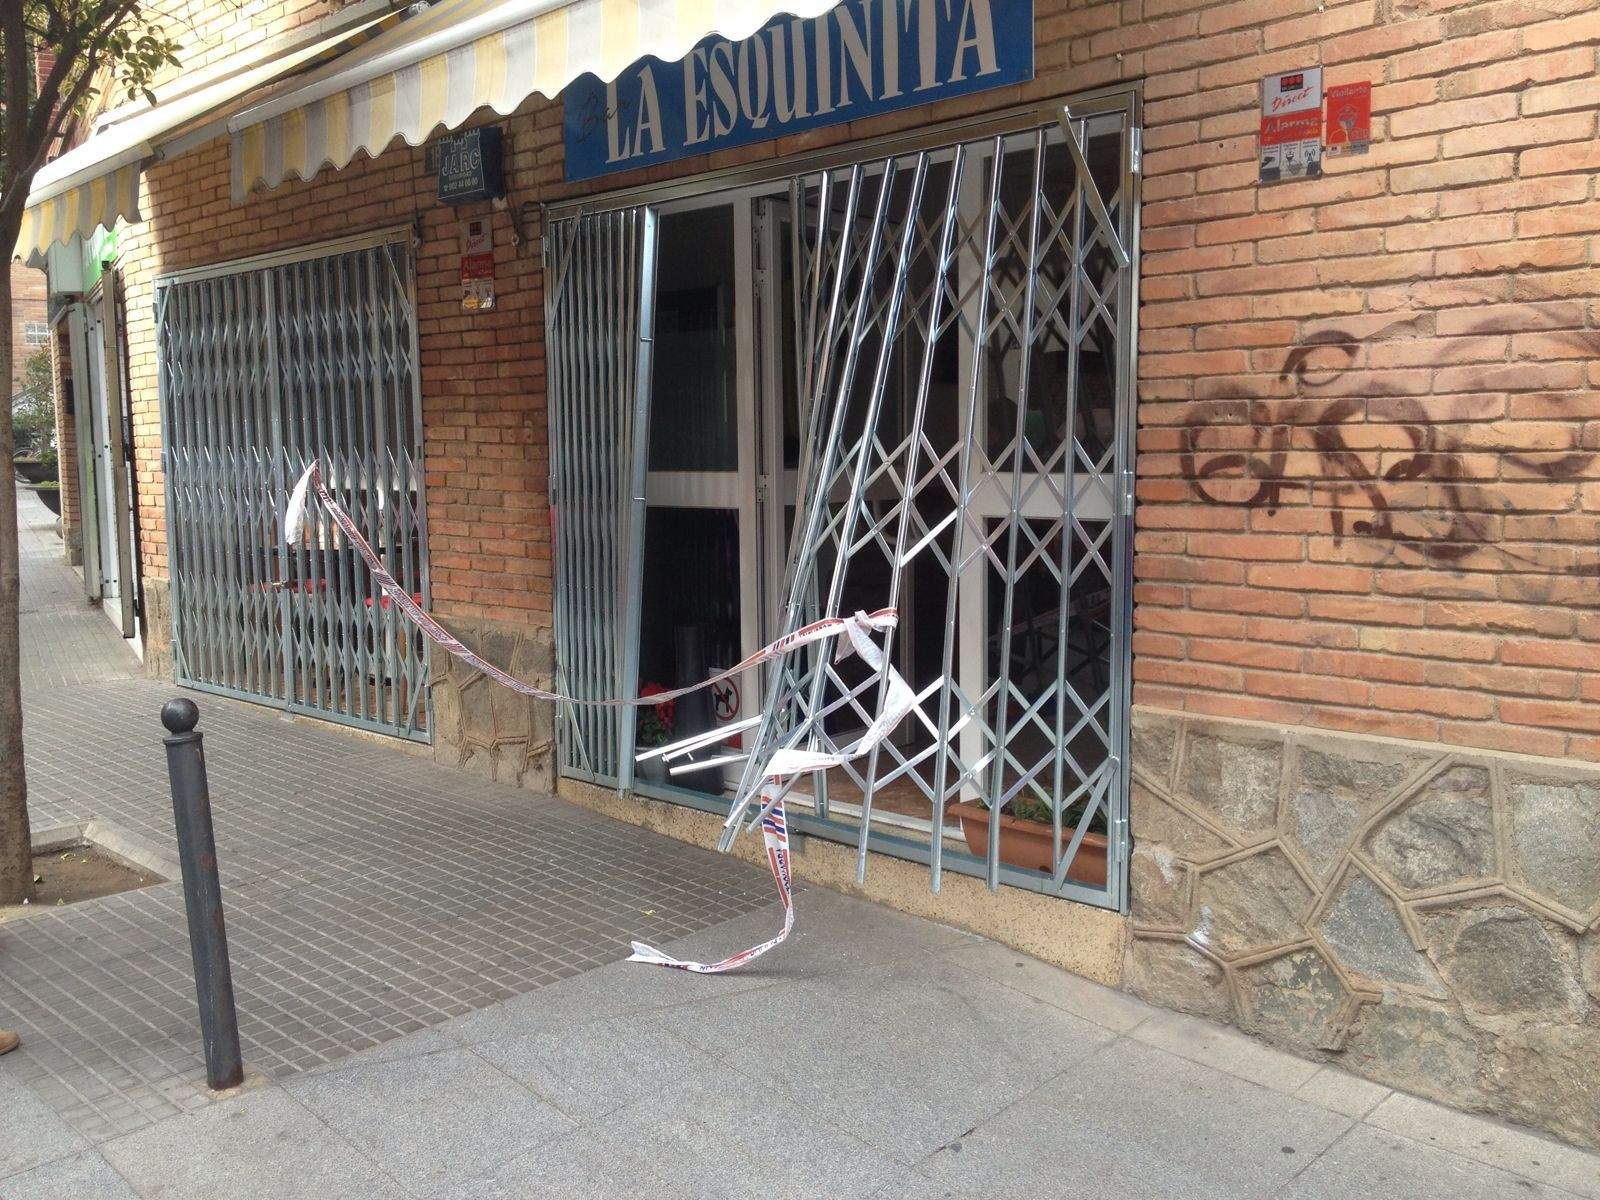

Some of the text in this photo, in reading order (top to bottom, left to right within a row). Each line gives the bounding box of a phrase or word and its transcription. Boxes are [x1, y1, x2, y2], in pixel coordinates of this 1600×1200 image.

[605, 0, 1001, 164] LA ESQUINITA
[442, 149, 480, 176] JARC
